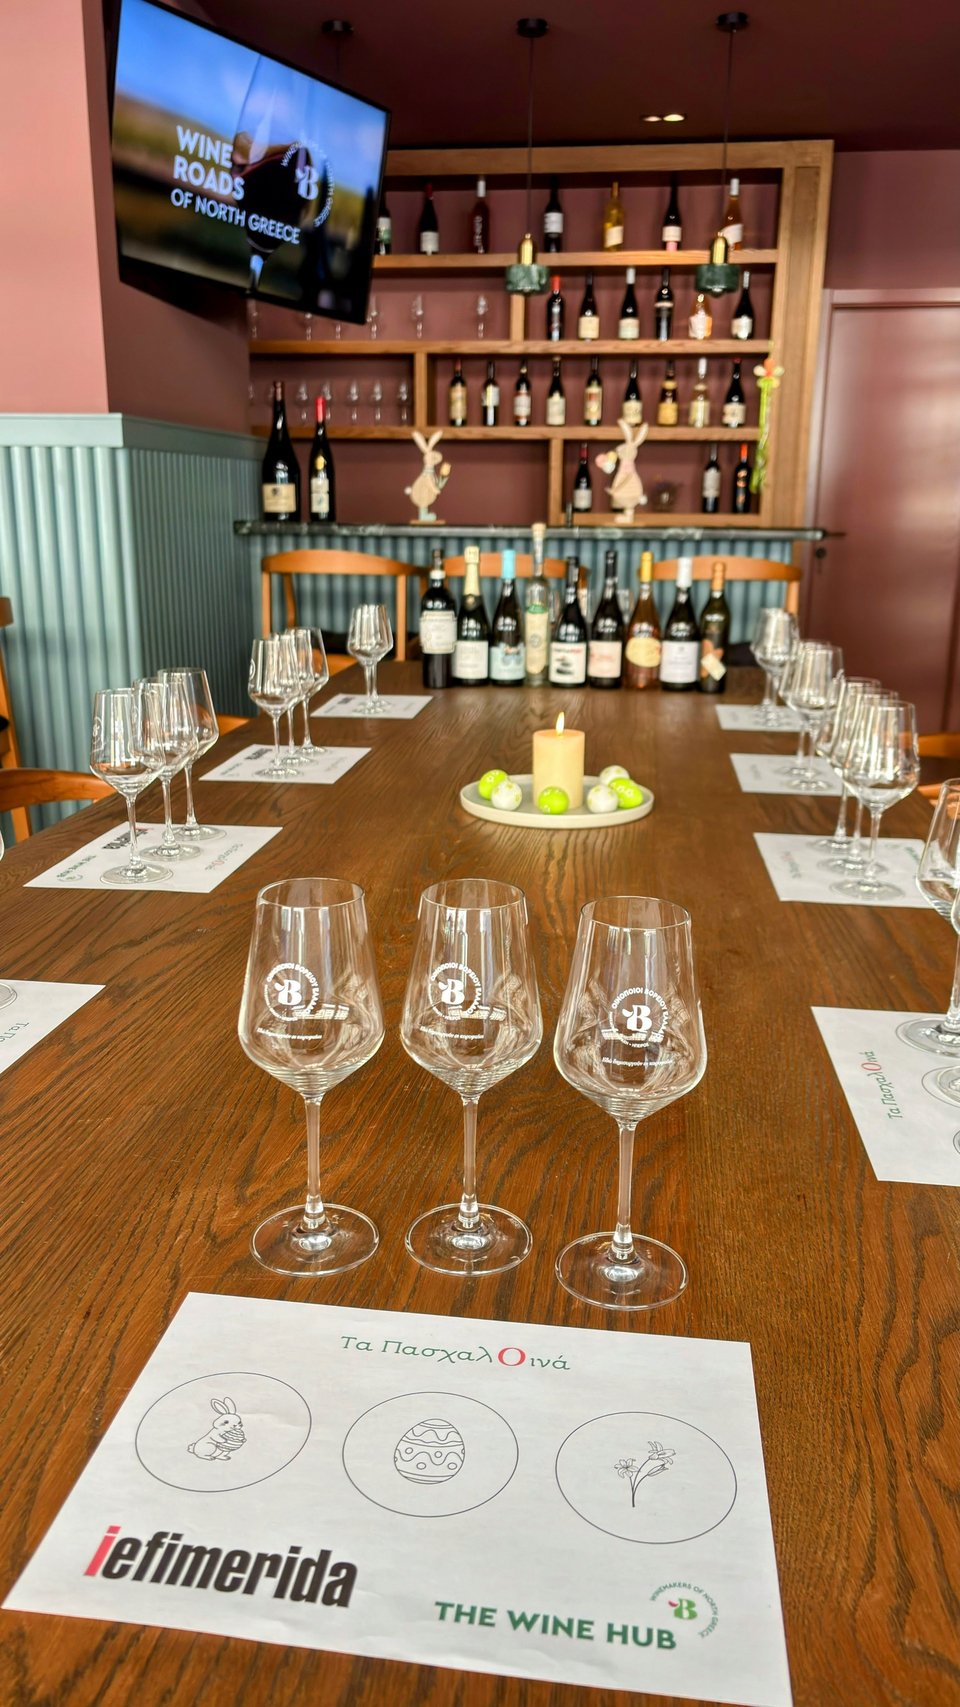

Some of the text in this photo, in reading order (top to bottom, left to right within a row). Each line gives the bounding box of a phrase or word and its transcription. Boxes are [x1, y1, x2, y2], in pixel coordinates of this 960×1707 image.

[176, 125, 234, 168] WINE
[173, 155, 245, 200] ROADS
[170, 188, 301, 245] OF NORTH GREECE
[887, 1106, 903, 1119] Τα
[341, 1336, 373, 1351] Τα
[84, 1525, 358, 1608] iefimerida
[435, 1601, 677, 1650] THE WINE HUB
